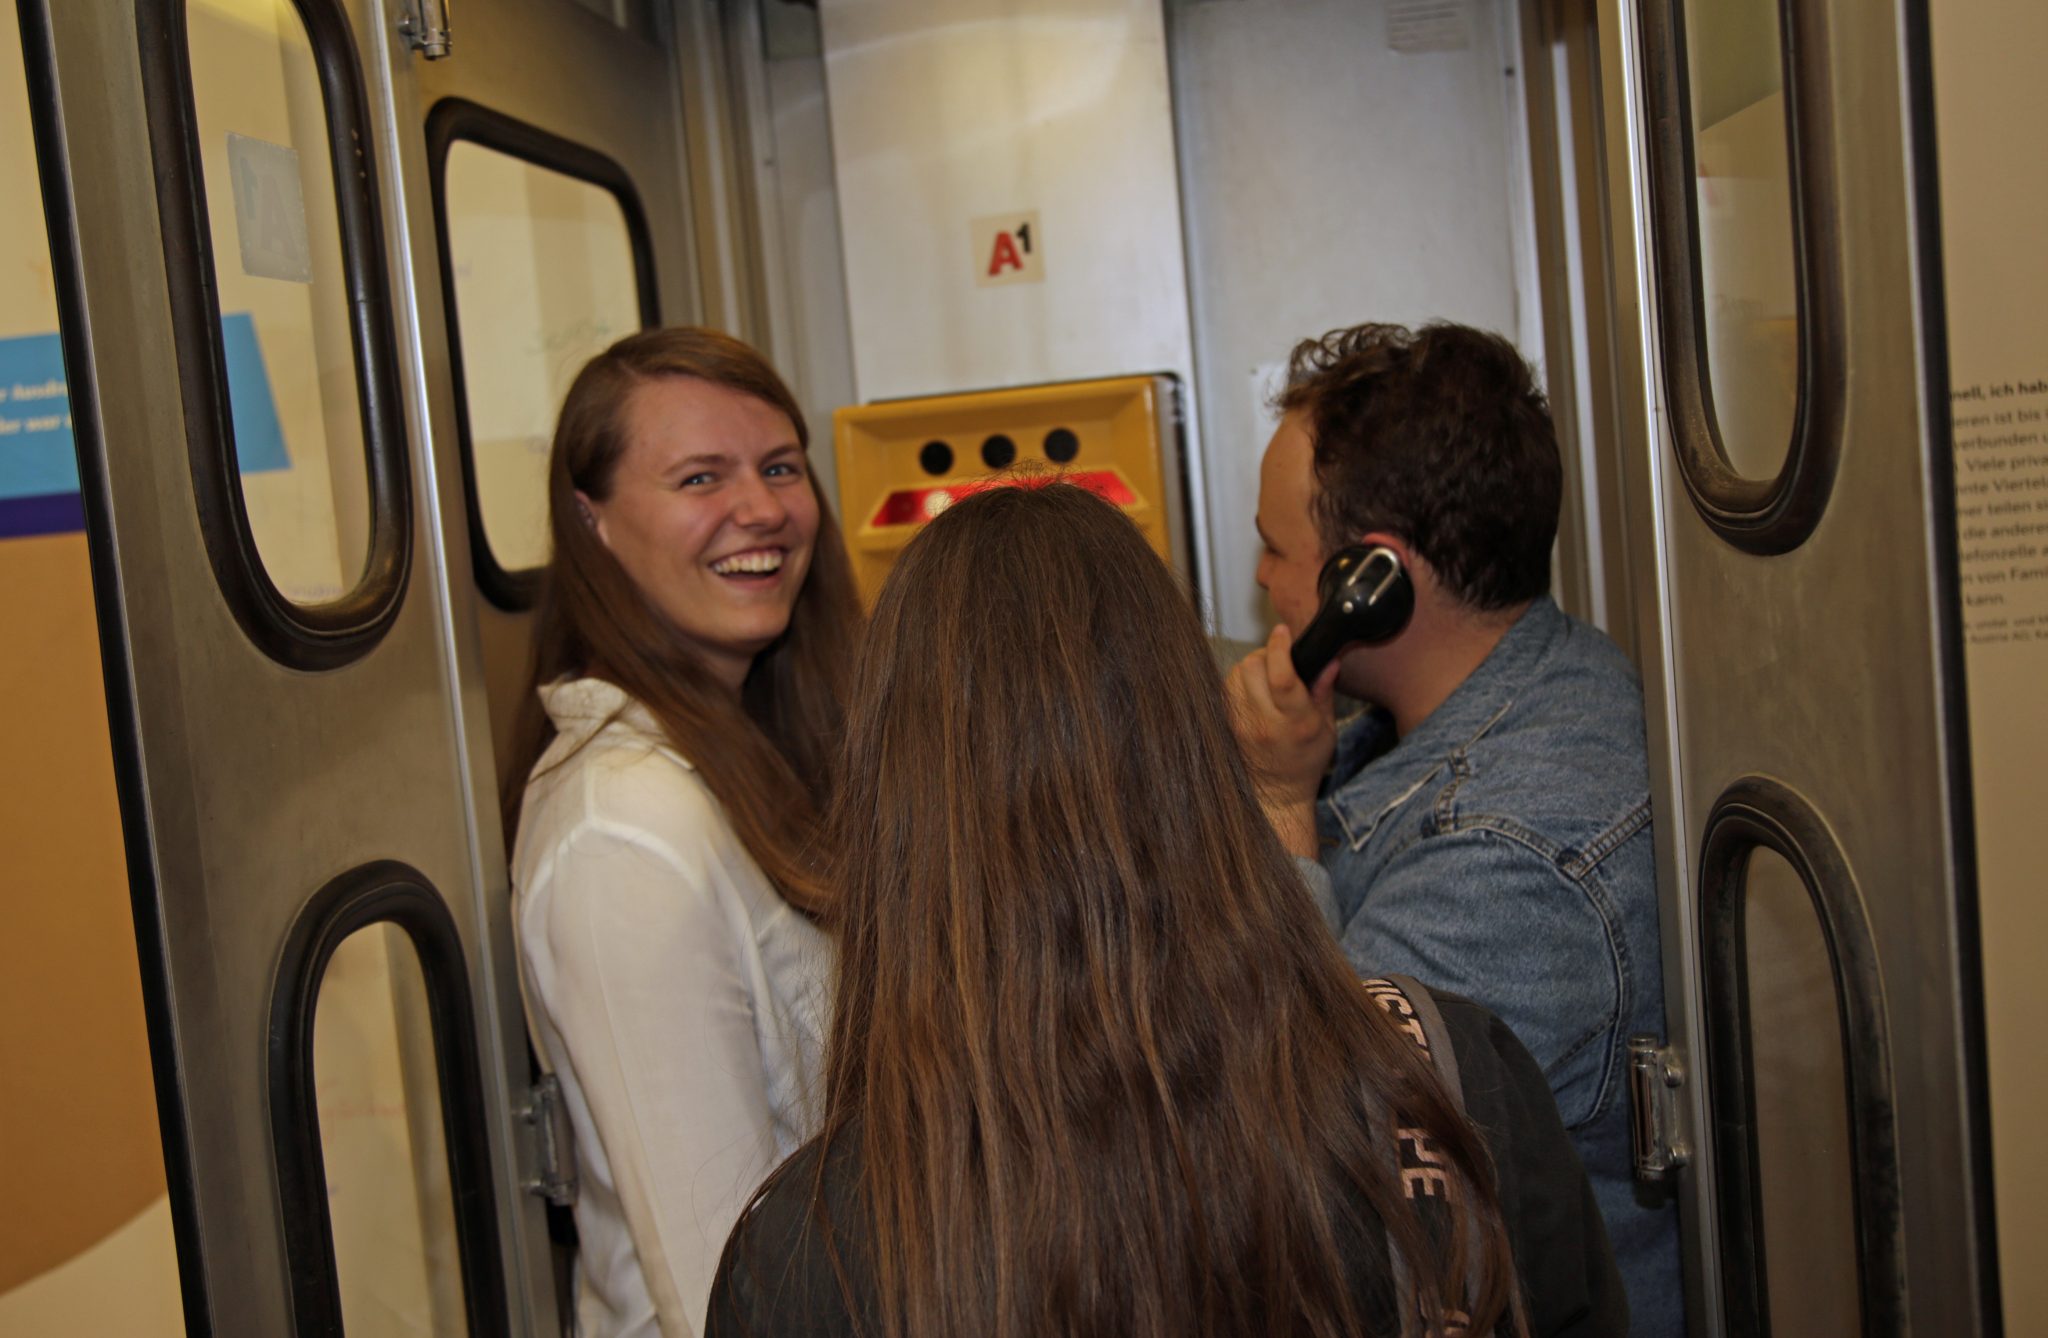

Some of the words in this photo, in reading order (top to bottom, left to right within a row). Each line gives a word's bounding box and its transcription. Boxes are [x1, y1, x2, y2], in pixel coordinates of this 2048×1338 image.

[987, 221, 1033, 277] A1
[1990, 383, 2014, 398] ich
[1965, 456, 2006, 472] Viele
